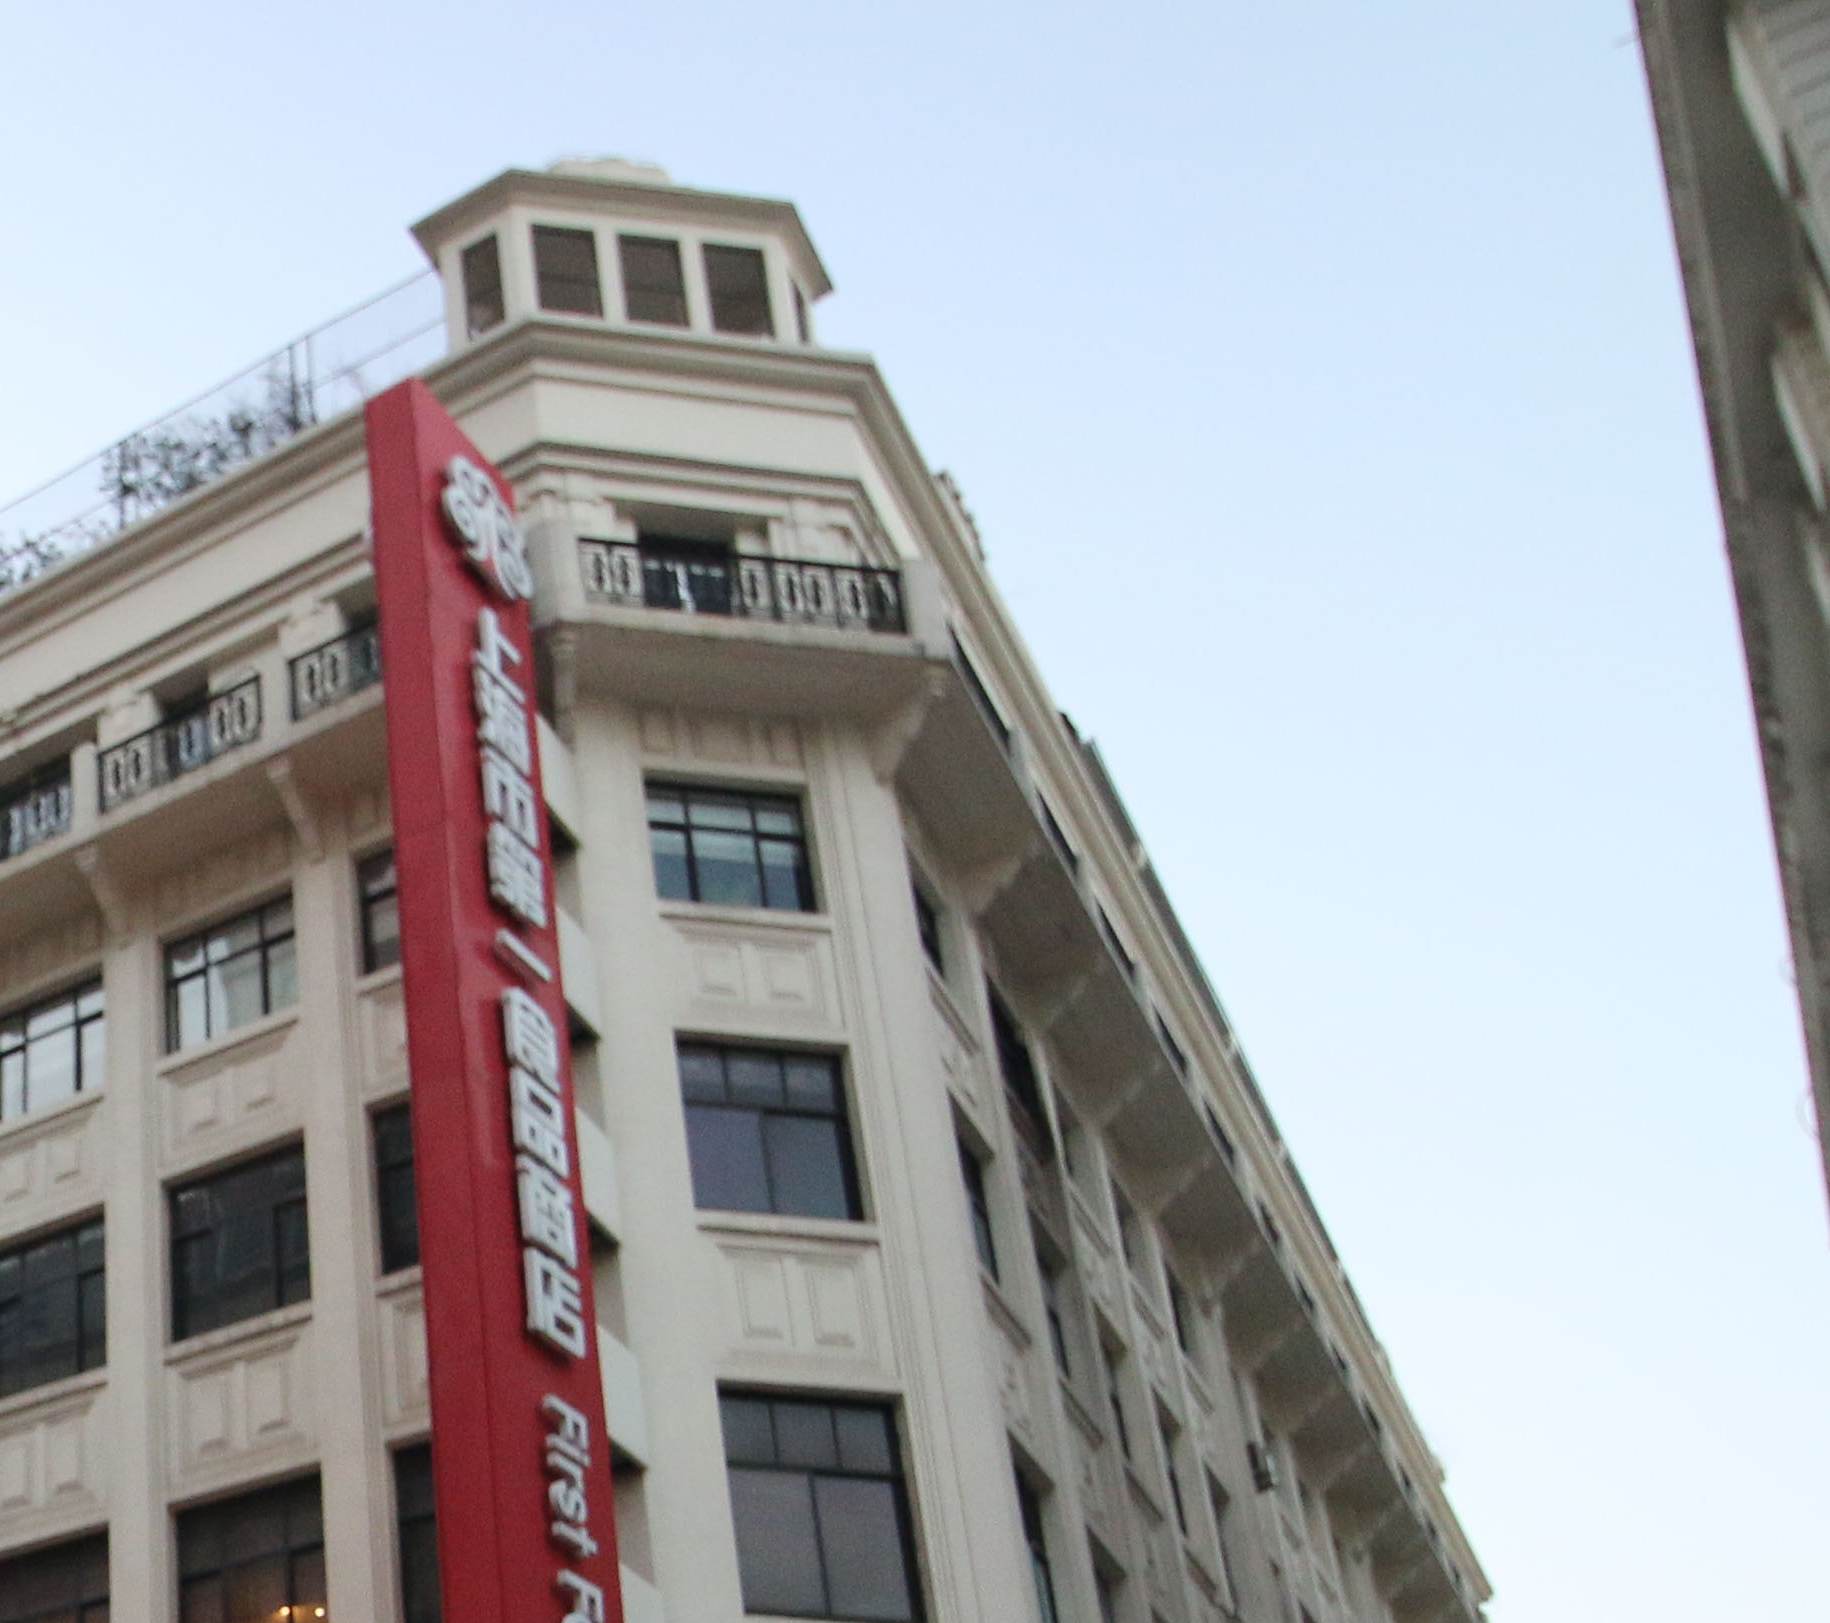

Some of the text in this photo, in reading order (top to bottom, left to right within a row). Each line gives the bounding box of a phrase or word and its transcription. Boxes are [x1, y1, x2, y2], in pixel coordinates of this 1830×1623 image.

[474, 606, 587, 1359] 上海市第一食品商店
[542, 1393, 598, 1559] First
